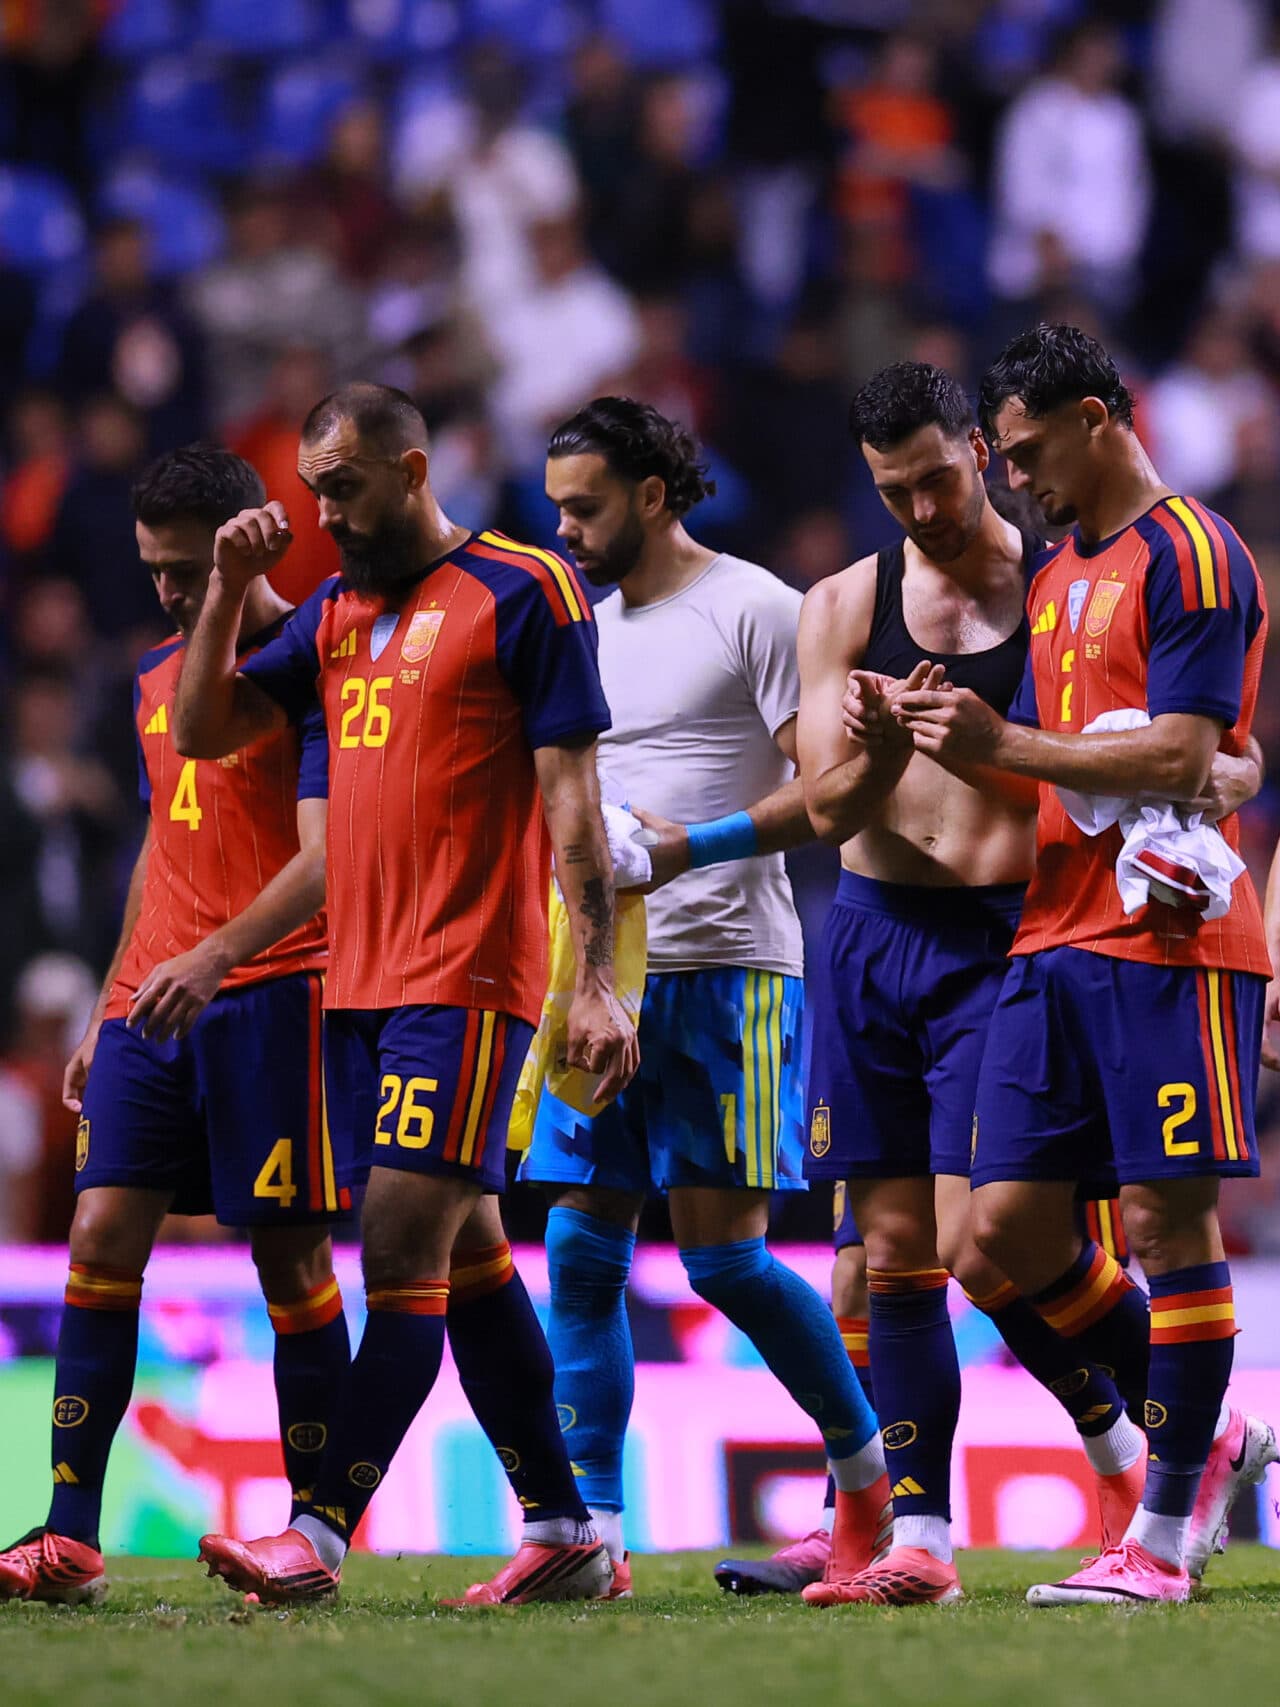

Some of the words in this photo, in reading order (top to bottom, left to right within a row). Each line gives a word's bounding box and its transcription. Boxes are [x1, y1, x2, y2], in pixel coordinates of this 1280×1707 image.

[339, 676, 394, 749] 26
[169, 759, 202, 831] 4
[374, 1073, 438, 1149] 26
[1157, 1082, 1200, 1157] 2
[254, 1138, 297, 1207] 4
